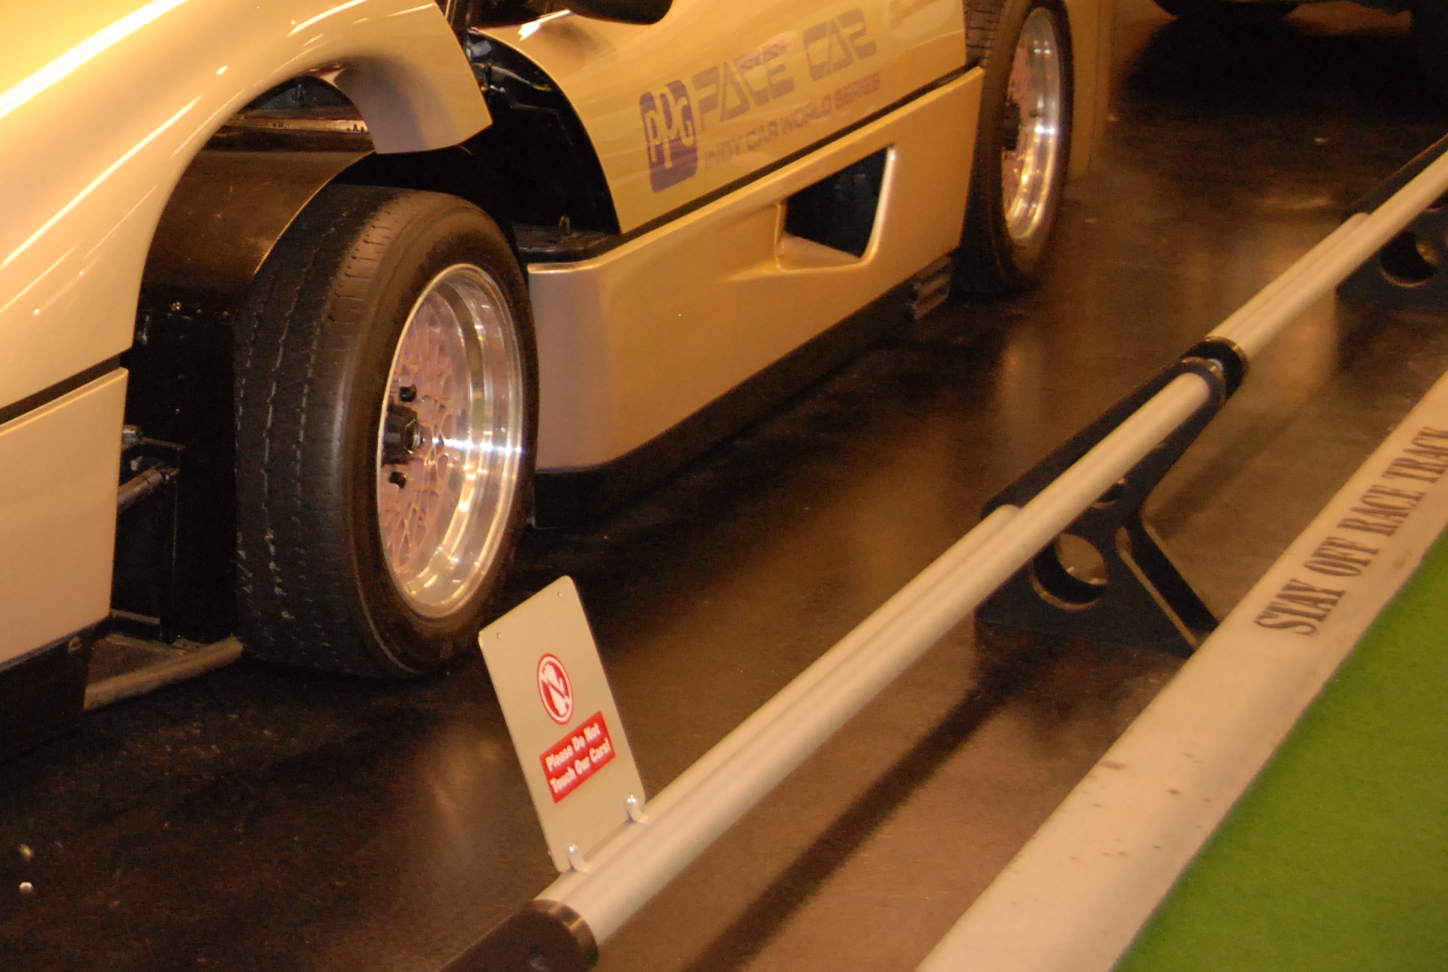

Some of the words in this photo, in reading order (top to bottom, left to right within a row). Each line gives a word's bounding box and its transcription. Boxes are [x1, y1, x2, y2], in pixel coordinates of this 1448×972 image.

[692, 41, 795, 132] PACE
[746, 119, 779, 151] CAR
[1336, 484, 1428, 537] RACE
[1304, 536, 1380, 577] OFF
[1253, 578, 1346, 636] STAY
[545, 744, 574, 772] Please
[571, 735, 586, 752] Do
[583, 722, 601, 742] Not
[549, 766, 577, 793] Touch
[574, 755, 591, 775] Our
[588, 737, 611, 763] Cars!
